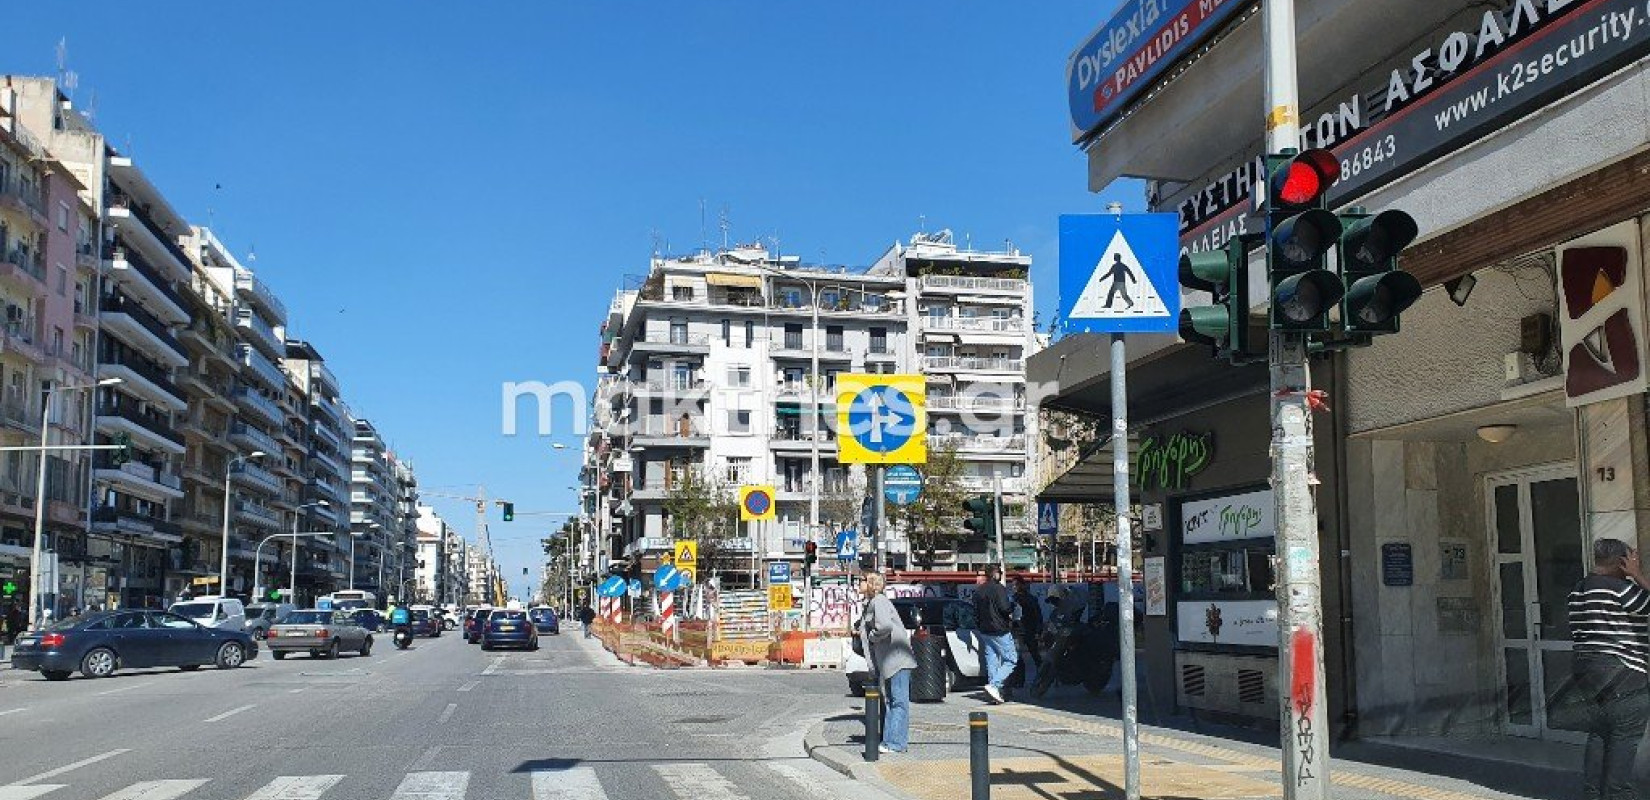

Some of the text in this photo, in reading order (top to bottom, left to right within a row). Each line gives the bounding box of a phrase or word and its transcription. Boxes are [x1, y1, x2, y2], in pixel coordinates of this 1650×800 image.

[1115, 13, 1190, 94] PAVLIDIS
[1332, 134, 1396, 188] 86843
[1435, 0, 1650, 131] www.k2security.
